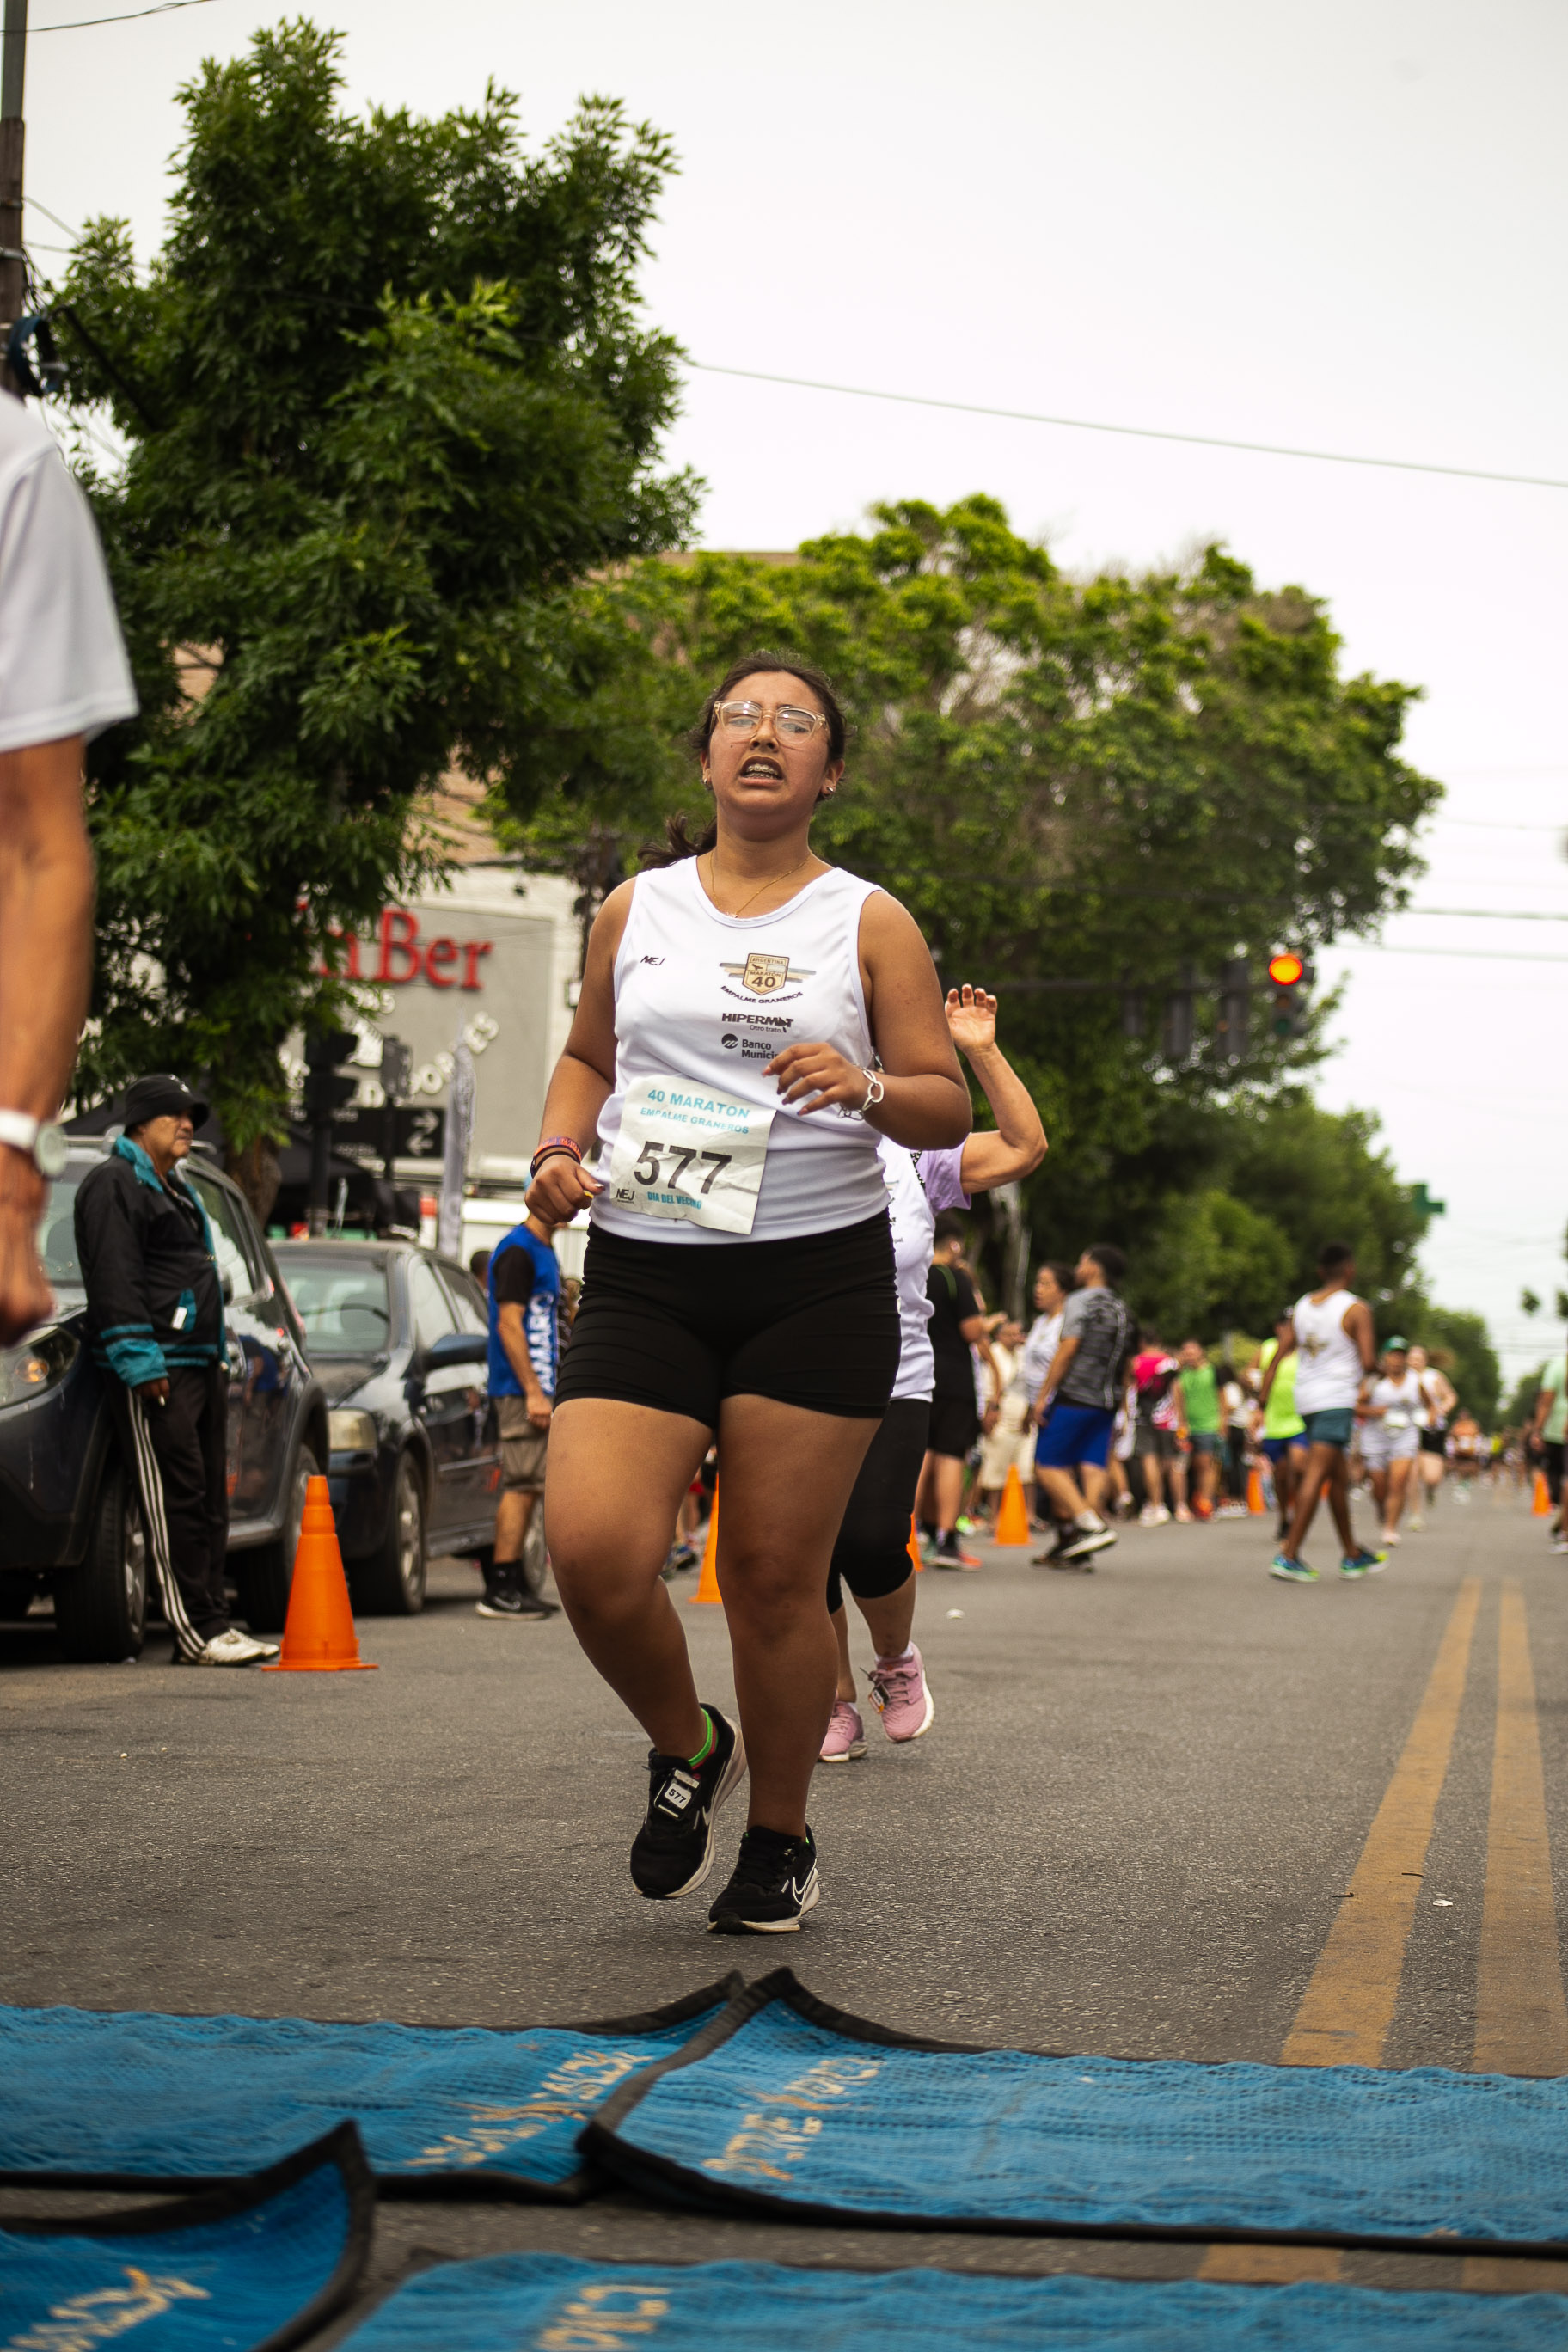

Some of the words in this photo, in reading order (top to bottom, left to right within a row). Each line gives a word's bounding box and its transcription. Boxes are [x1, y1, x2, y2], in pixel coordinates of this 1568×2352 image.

[751, 976, 776, 988] 40
[720, 985, 756, 1003] EMPALME
[758, 991, 803, 1004] GRANEROS
[742, 1038, 772, 1050] Banco
[741, 1049, 778, 1059] Munici
[647, 1089, 665, 1102] 40
[670, 1093, 750, 1118] MARATON
[640, 1107, 687, 1123] EMPALME
[690, 1115, 750, 1135] GRANEROS
[634, 1141, 732, 1195] 577
[616, 1188, 635, 1201] NEJ
[647, 1191, 660, 1202] DIA
[661, 1193, 674, 1204] DEL
[676, 1195, 702, 1210] VECINO
[668, 1788, 687, 1804] 577
